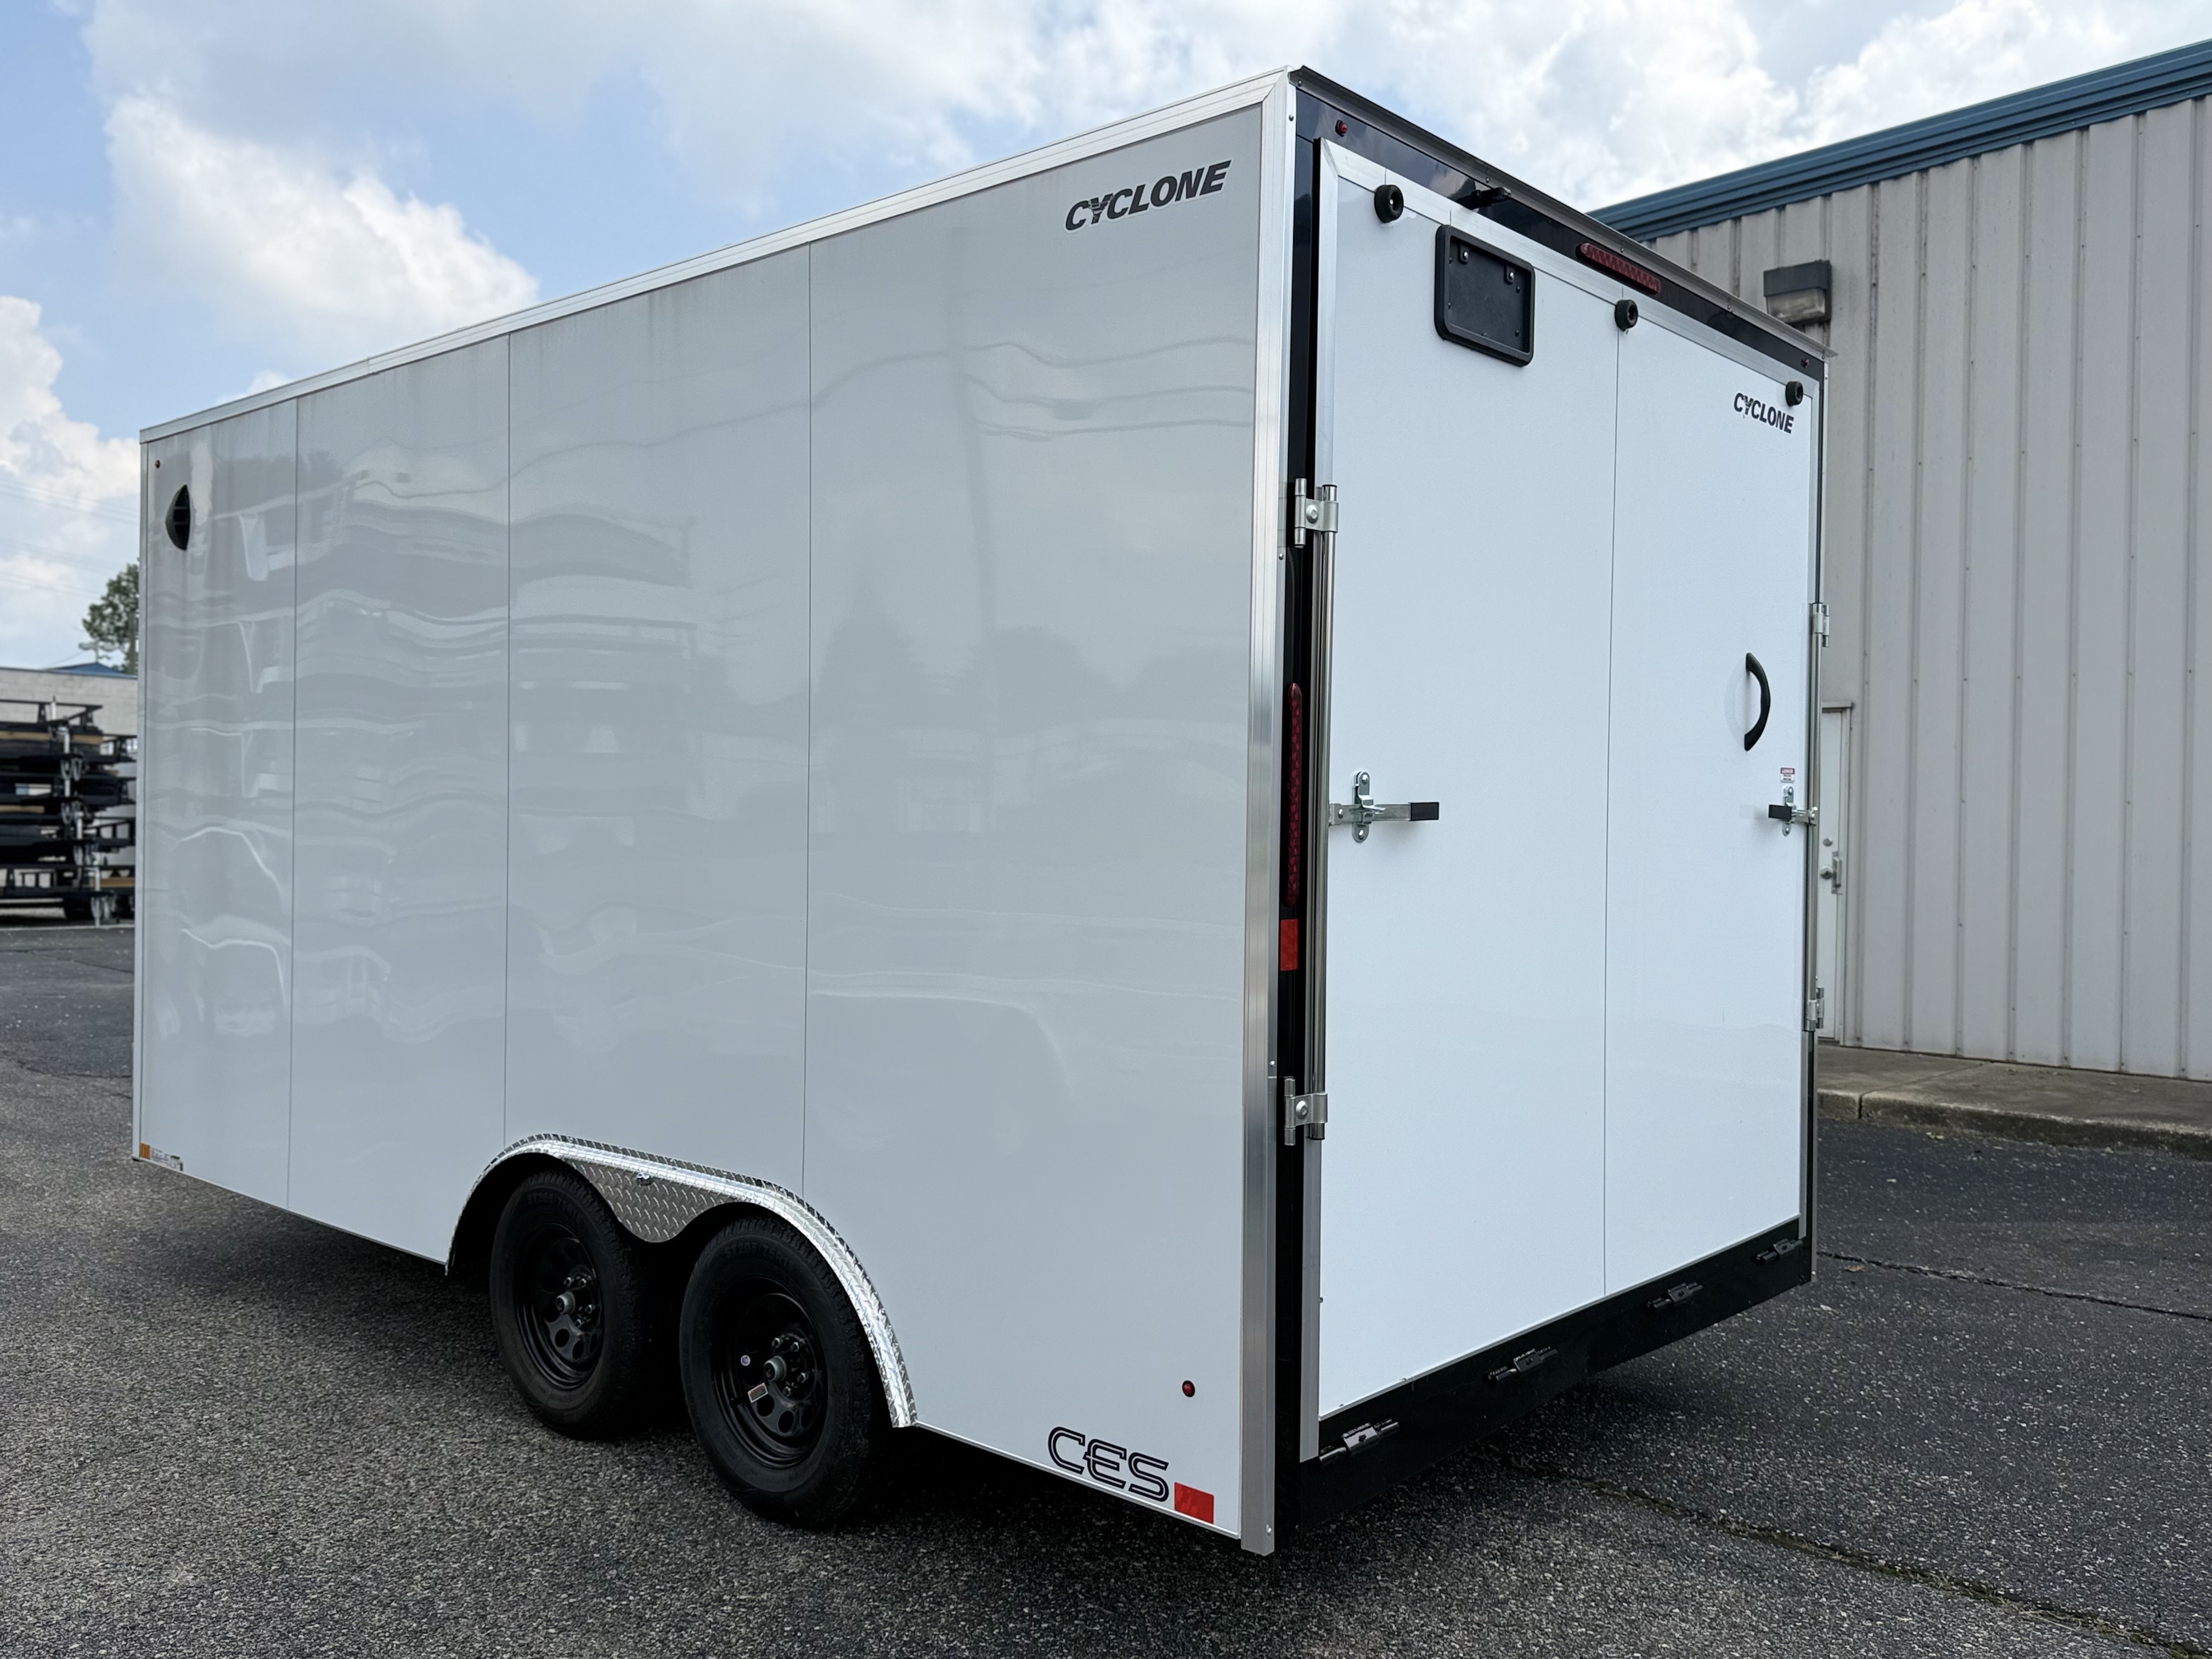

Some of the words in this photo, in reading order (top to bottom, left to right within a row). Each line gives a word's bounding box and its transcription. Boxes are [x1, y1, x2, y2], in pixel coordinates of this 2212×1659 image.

[1065, 159, 1232, 231] CYCLONE
[1734, 392, 1795, 435] CYCLONE
[1048, 1426, 1170, 1502] CES
